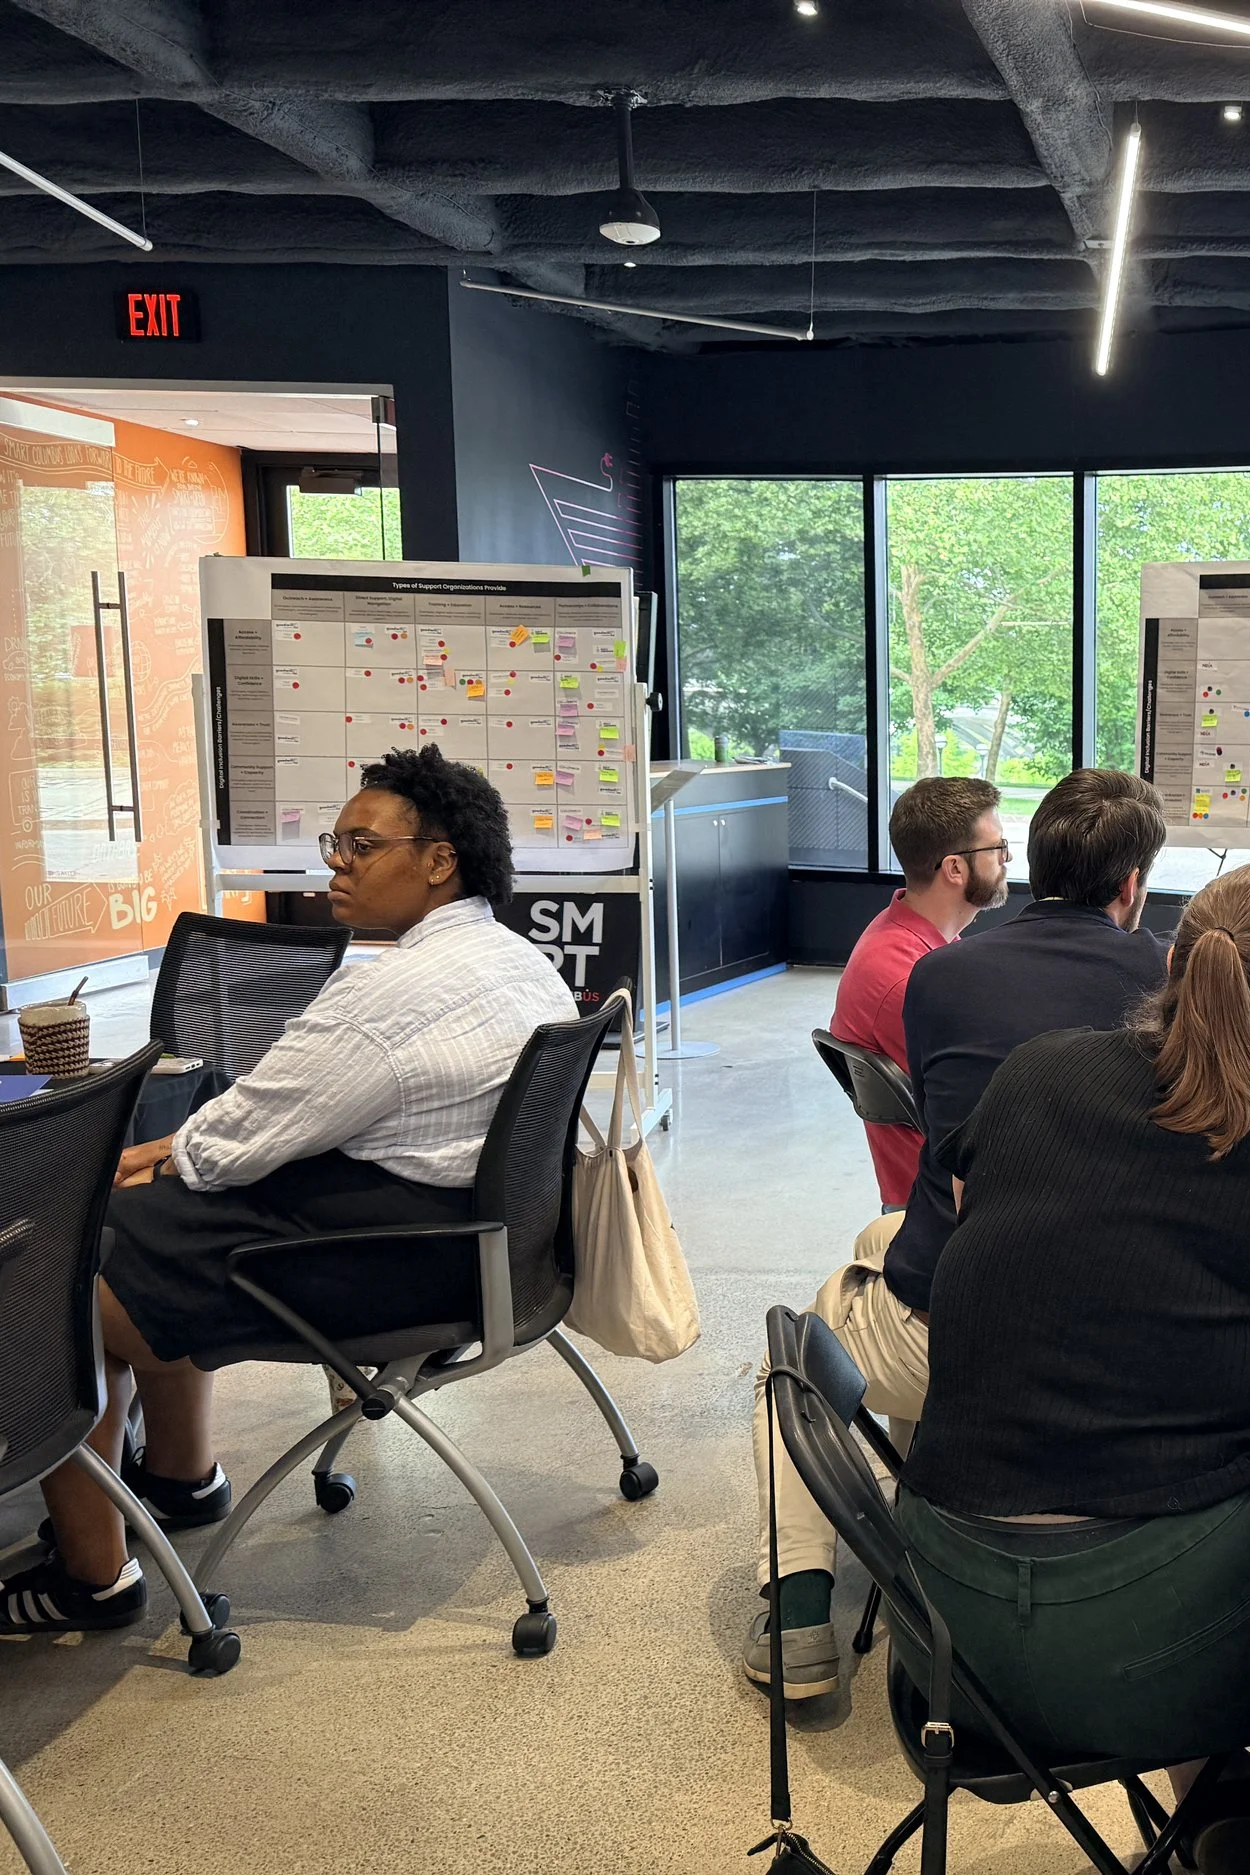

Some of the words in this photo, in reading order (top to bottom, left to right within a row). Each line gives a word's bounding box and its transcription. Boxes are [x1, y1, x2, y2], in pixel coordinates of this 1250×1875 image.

[128, 293, 181, 336] EXIT
[4, 438, 29, 462] SMART
[32, 446, 63, 465] COLUMBUS
[64, 445, 83, 464] LOOKS
[85, 445, 112, 470] FORWAR
[392, 582, 410, 591] Types
[419, 582, 442, 591] Support
[442, 583, 483, 591] Organizations
[215, 686, 223, 743] Barriers/Challenges
[218, 770, 226, 789] Digital
[145, 868, 153, 881] BE
[24, 883, 52, 911] OUR
[51, 887, 94, 932] FUTURE
[108, 886, 158, 930] BIG
[527, 899, 604, 944] SM
[571, 988, 600, 1002] BUS
